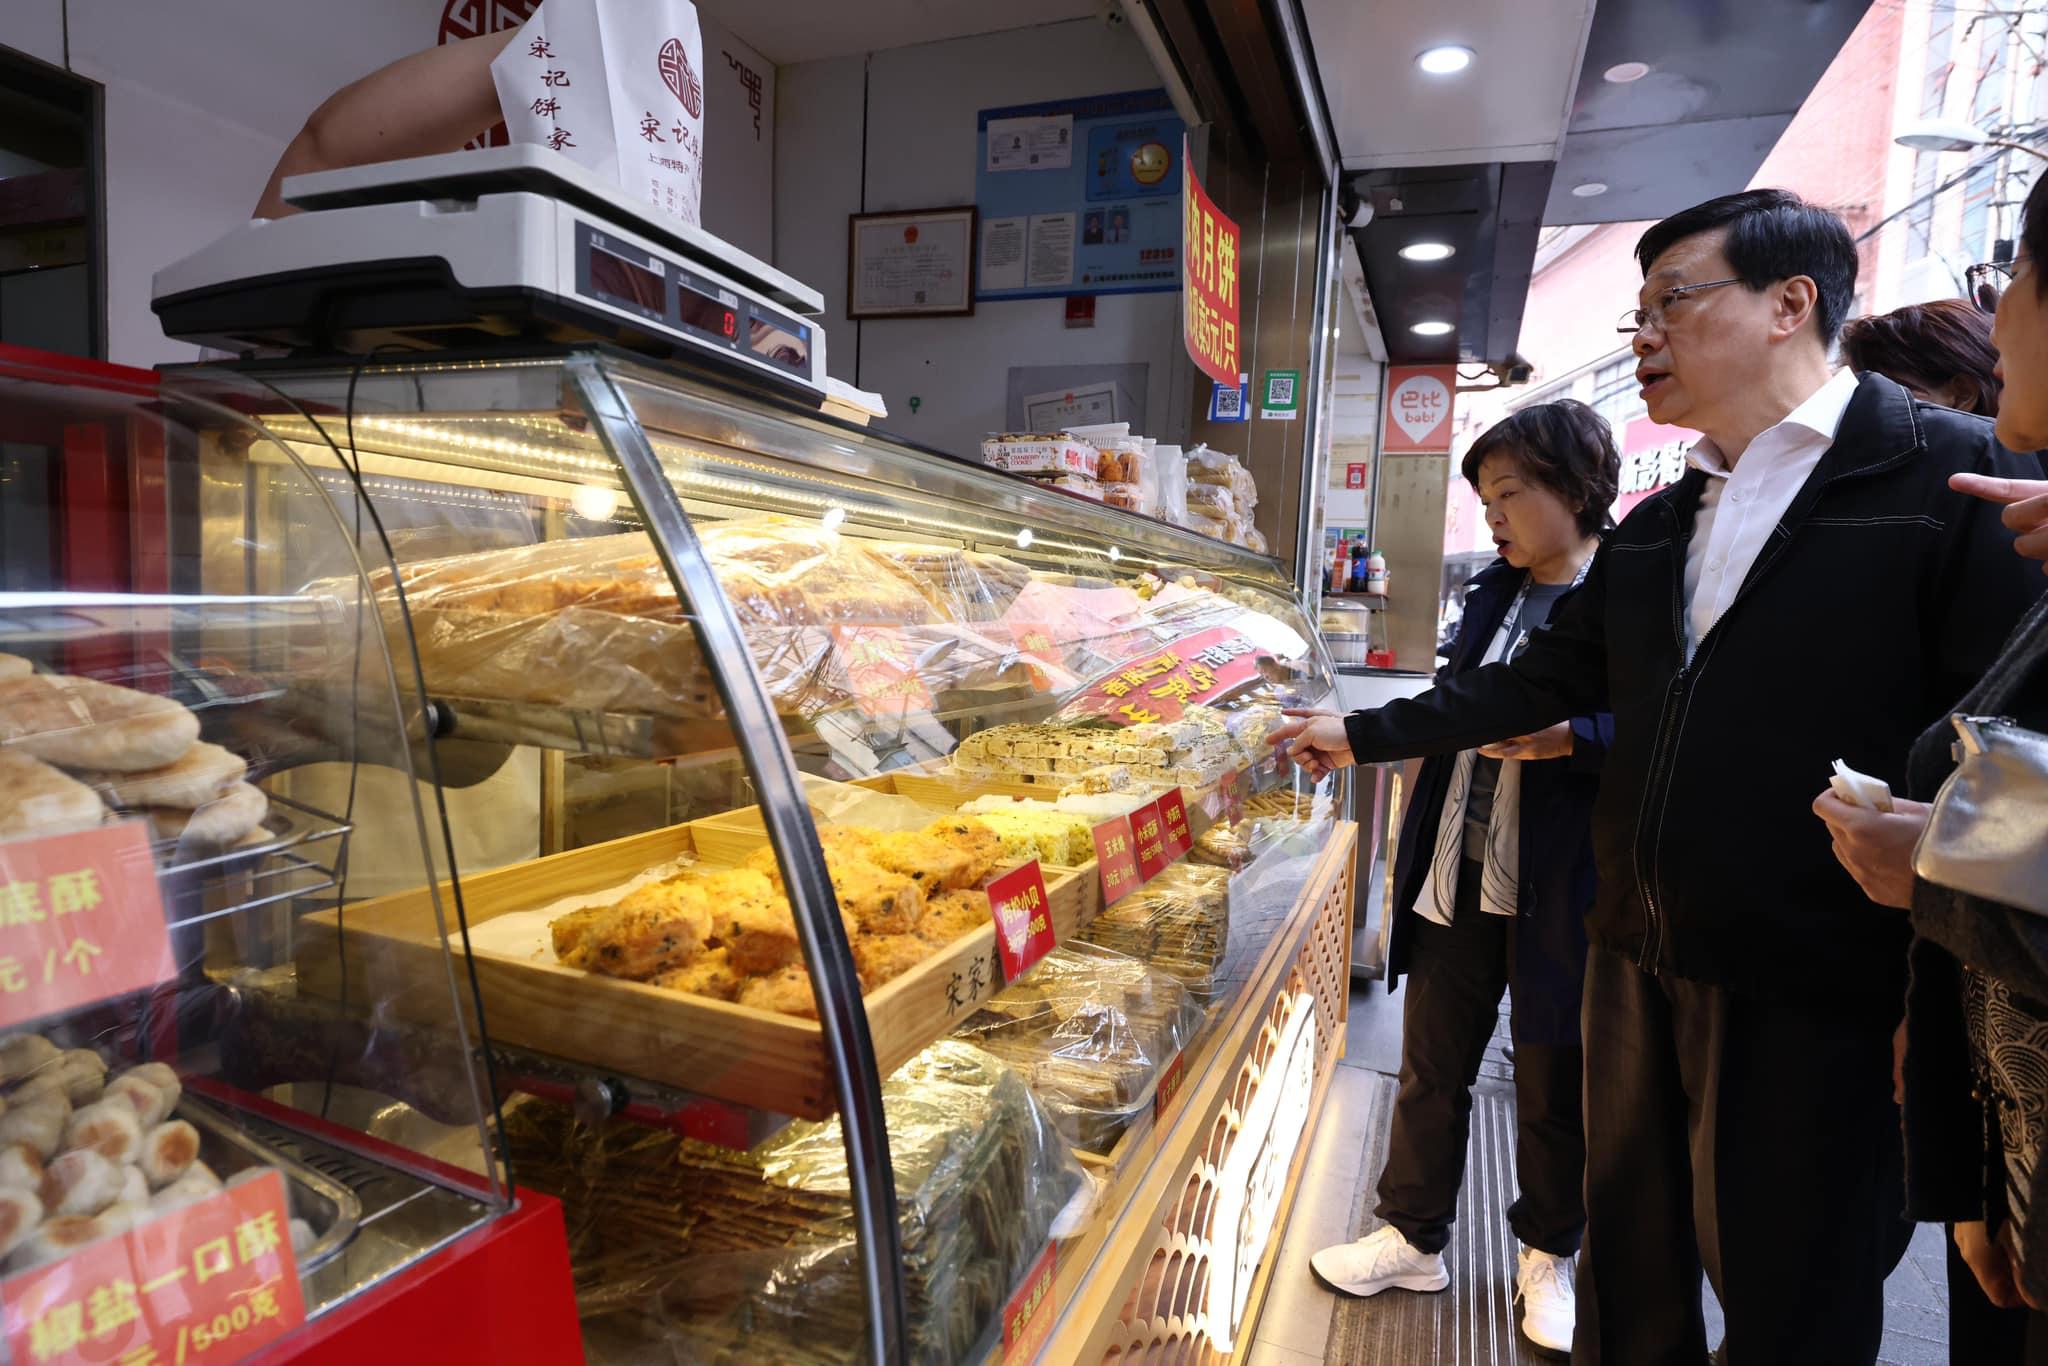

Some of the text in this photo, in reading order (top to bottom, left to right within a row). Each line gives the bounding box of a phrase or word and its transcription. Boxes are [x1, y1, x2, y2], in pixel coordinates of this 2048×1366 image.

[528, 36, 577, 151] 宋记饼家
[723, 312, 735, 337] 0
[1401, 390, 1442, 409] 巴比
[29, 1210, 282, 1363] 椒盐一口酥
